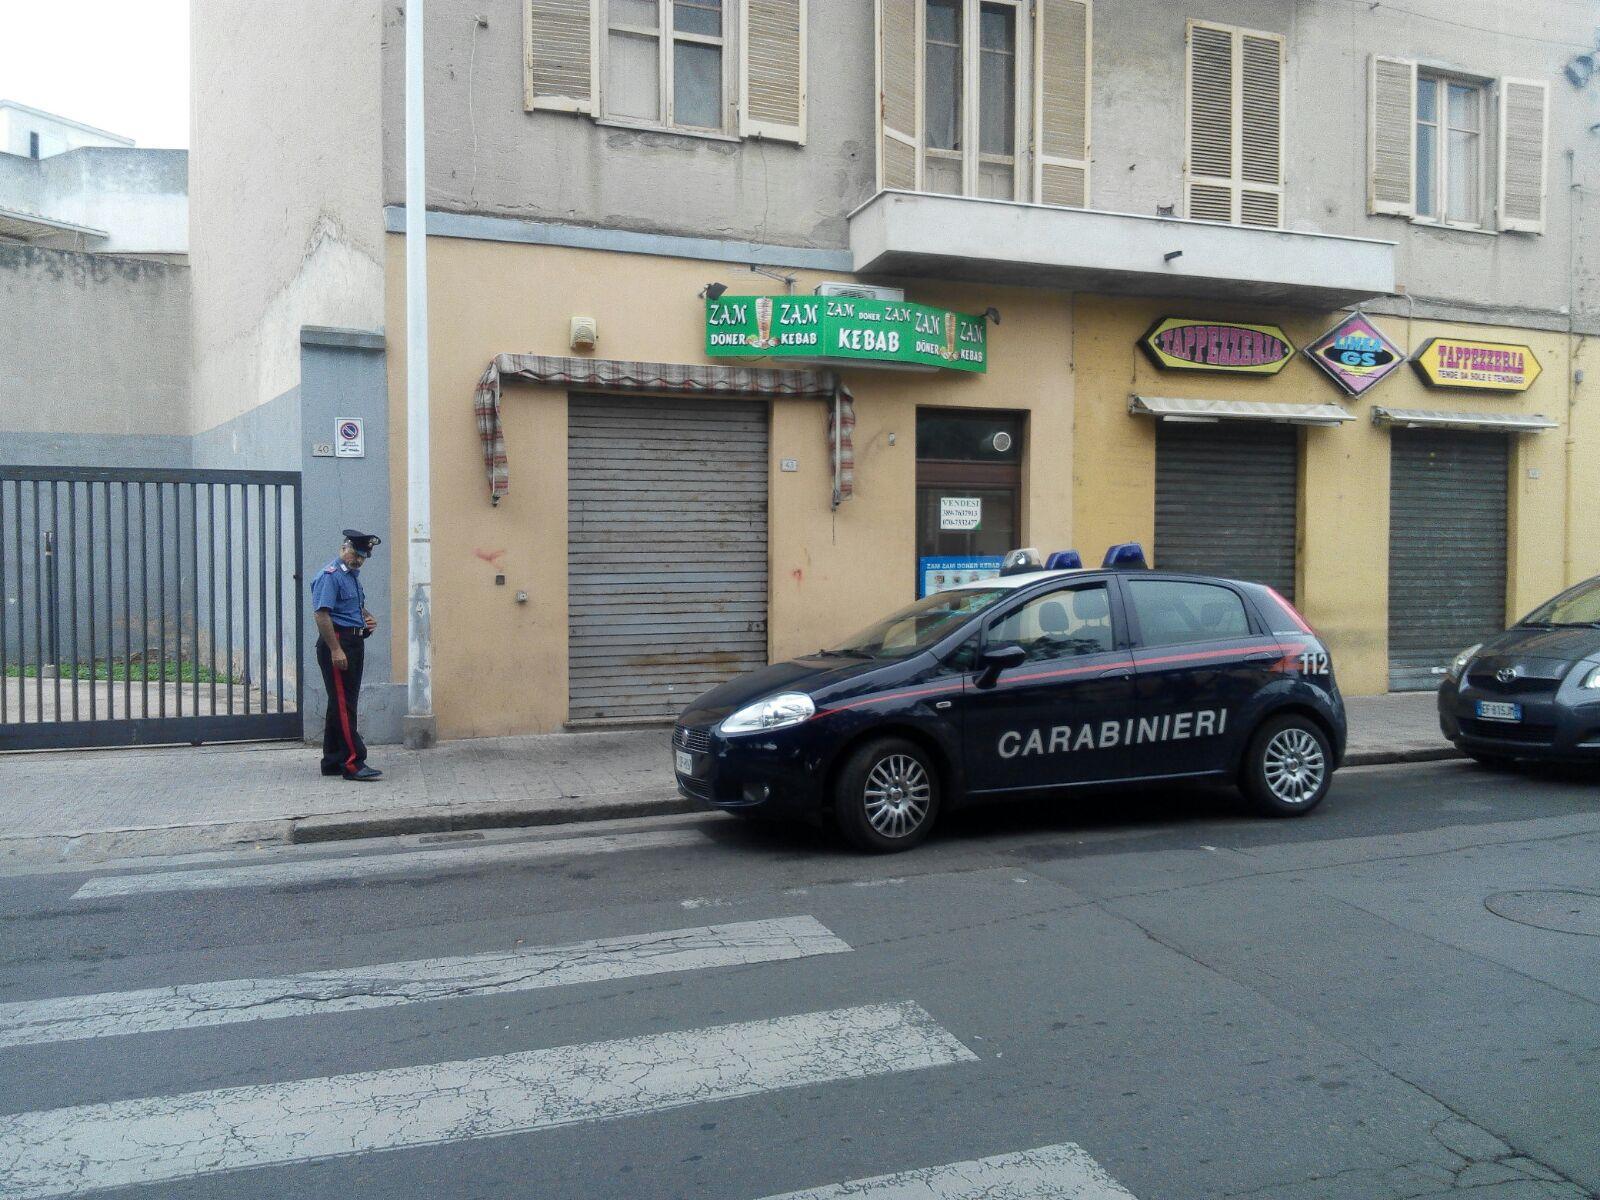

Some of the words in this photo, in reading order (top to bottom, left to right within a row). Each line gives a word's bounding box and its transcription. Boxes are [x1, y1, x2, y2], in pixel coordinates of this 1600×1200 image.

[709, 304, 748, 325] ZAM
[780, 304, 818, 325] ZAM
[826, 302, 854, 317] ZAM
[884, 307, 911, 322] ZAM
[915, 312, 940, 335] ZAM
[959, 321, 983, 344] ZAM
[780, 332, 818, 346] KEBAB
[838, 327, 900, 353] KEBAB
[1160, 326, 1284, 366] TAPPEZZERIA
[1334, 335, 1384, 353] LINEA
[960, 350, 983, 363] KEBAB
[1340, 351, 1377, 367] GS
[1438, 345, 1525, 375] TAPPEZZERIA
[1438, 369, 1459, 380] TENDE
[317, 445, 330, 454] 40
[1300, 652, 1329, 675] 112
[998, 708, 1227, 759] CARABINIERI
